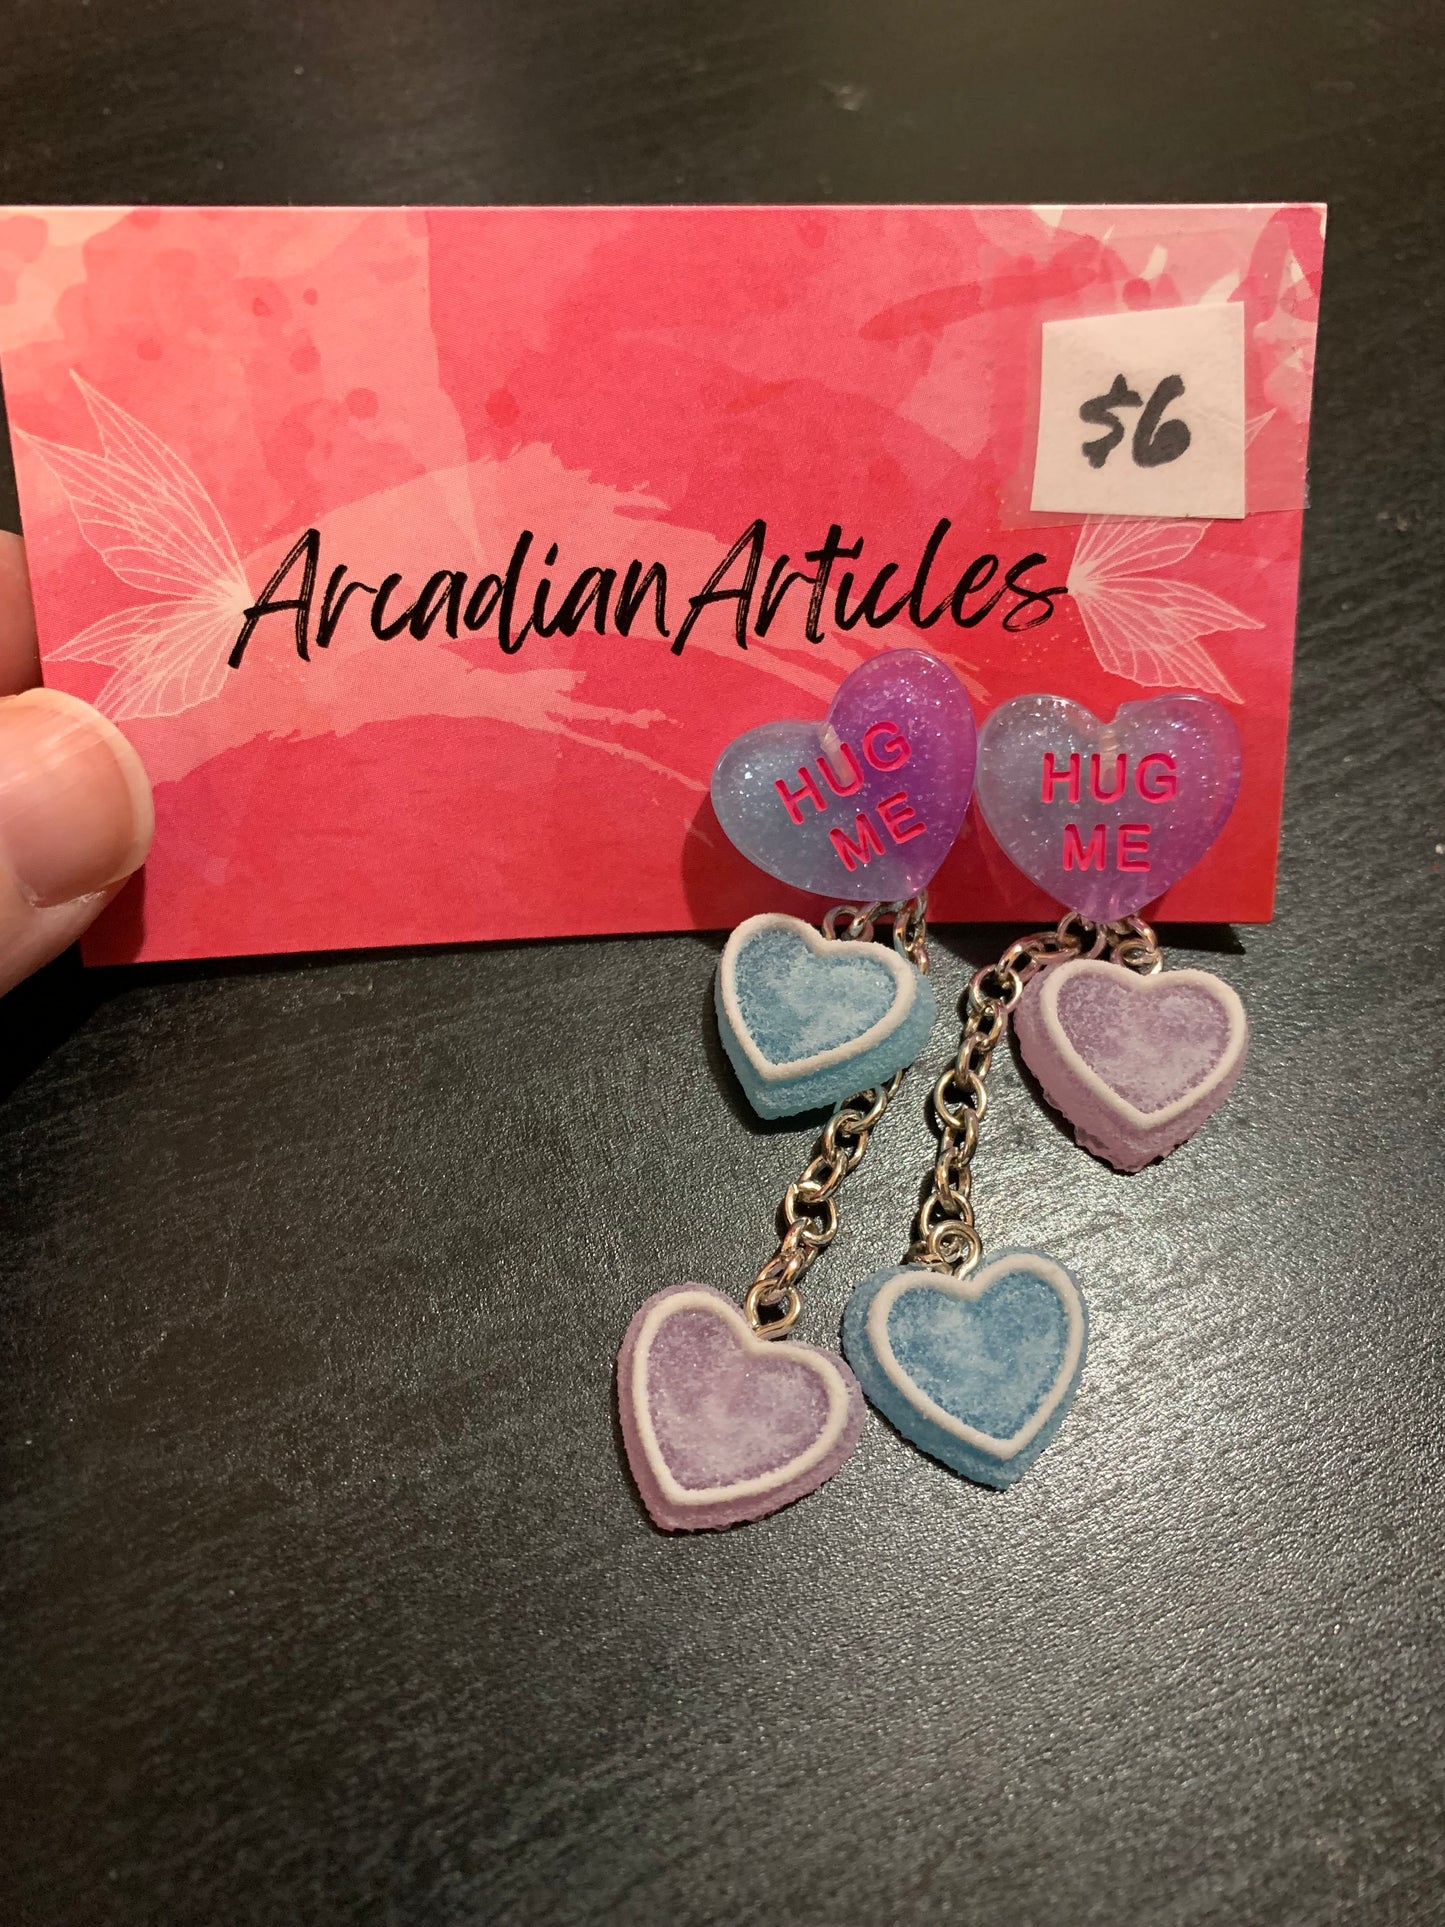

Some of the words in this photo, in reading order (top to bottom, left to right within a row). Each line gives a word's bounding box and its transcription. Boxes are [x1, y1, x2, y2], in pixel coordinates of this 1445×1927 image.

[1079, 373, 1191, 469] $6
[774, 721, 912, 825] HUG
[1041, 752, 1178, 804] HUG
[828, 791, 926, 872] ME
[1062, 823, 1151, 872] ME
